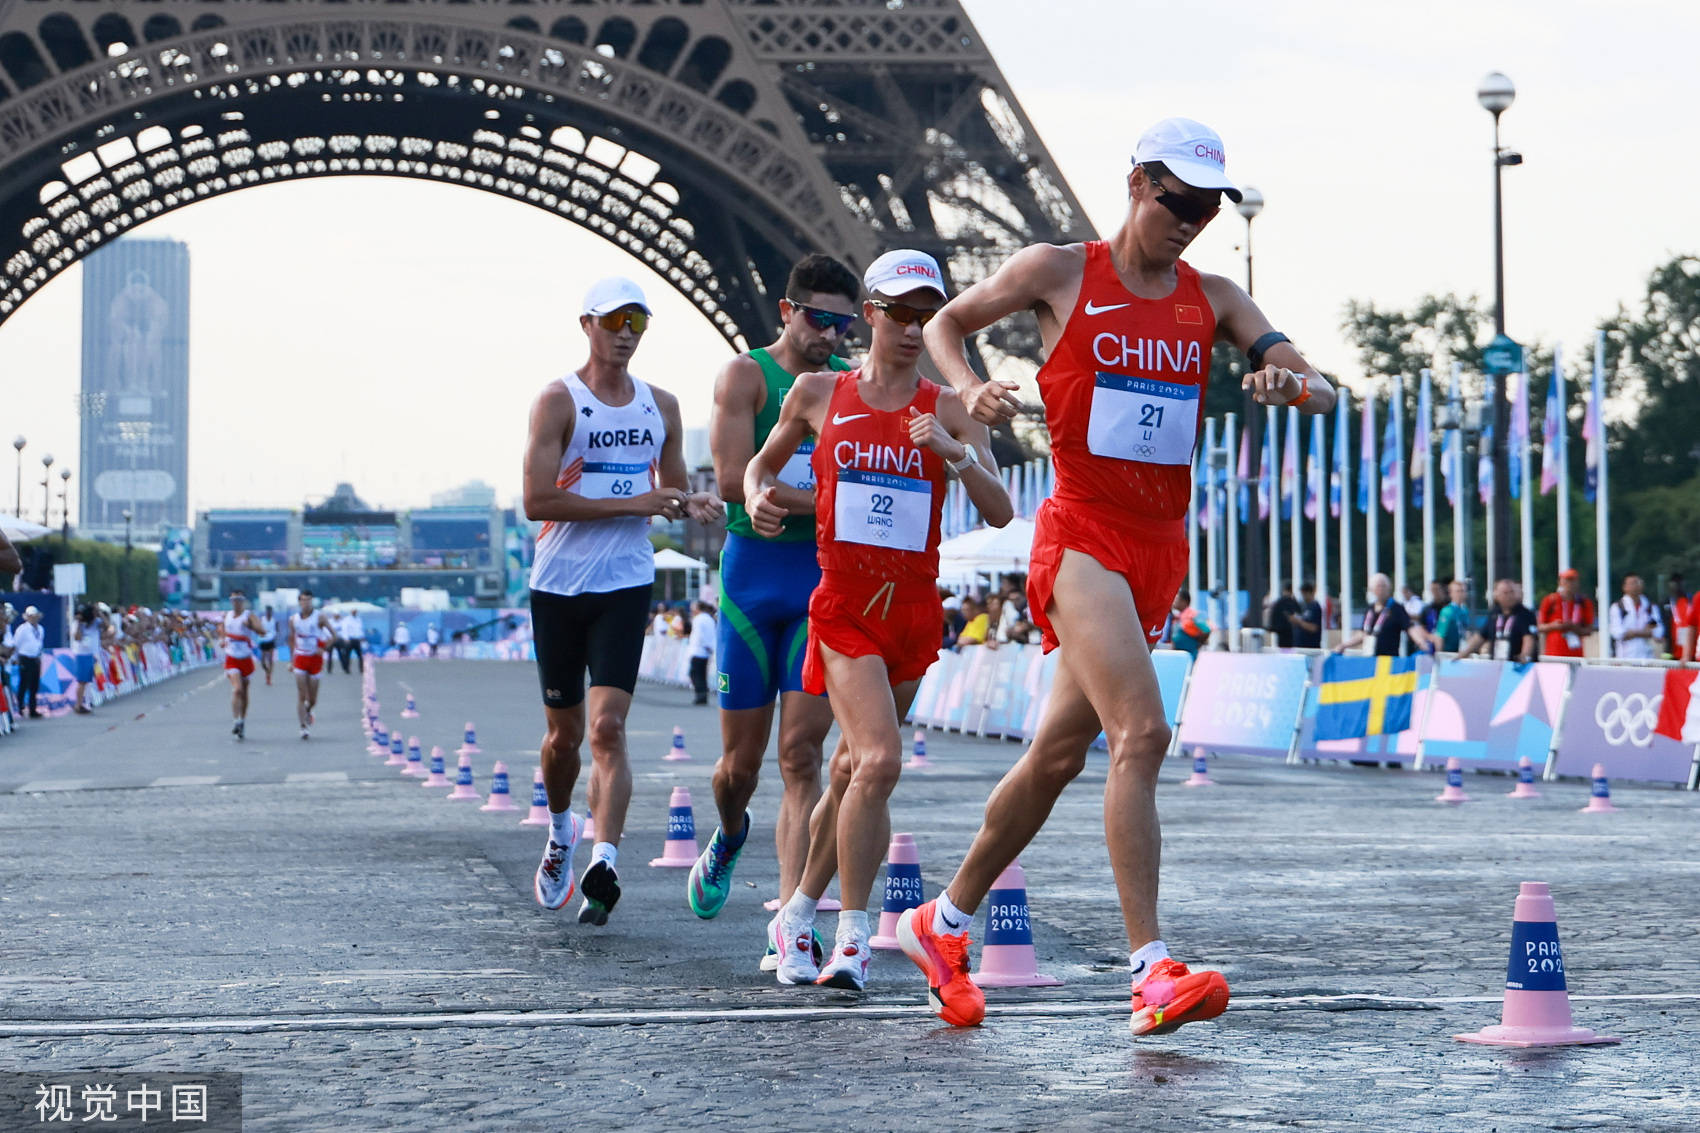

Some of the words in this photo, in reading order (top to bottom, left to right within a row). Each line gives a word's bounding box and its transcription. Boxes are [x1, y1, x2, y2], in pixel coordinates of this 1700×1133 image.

[1092, 332, 1201, 374] CHINA
[1126, 380, 1156, 392] PARIS
[1158, 385, 1184, 396] 2024
[1138, 403, 1164, 429] 21
[588, 429, 654, 448] KOREA
[1143, 430, 1152, 441] LI
[834, 440, 923, 478] CHINA
[861, 474, 885, 484] PARIS
[611, 479, 633, 496] 62
[871, 493, 894, 515] 22
[867, 515, 893, 528] WANG
[886, 877, 920, 889] PARIS
[885, 889, 921, 900] 2024
[991, 904, 1029, 917] PARIS
[991, 918, 1030, 931] 2024
